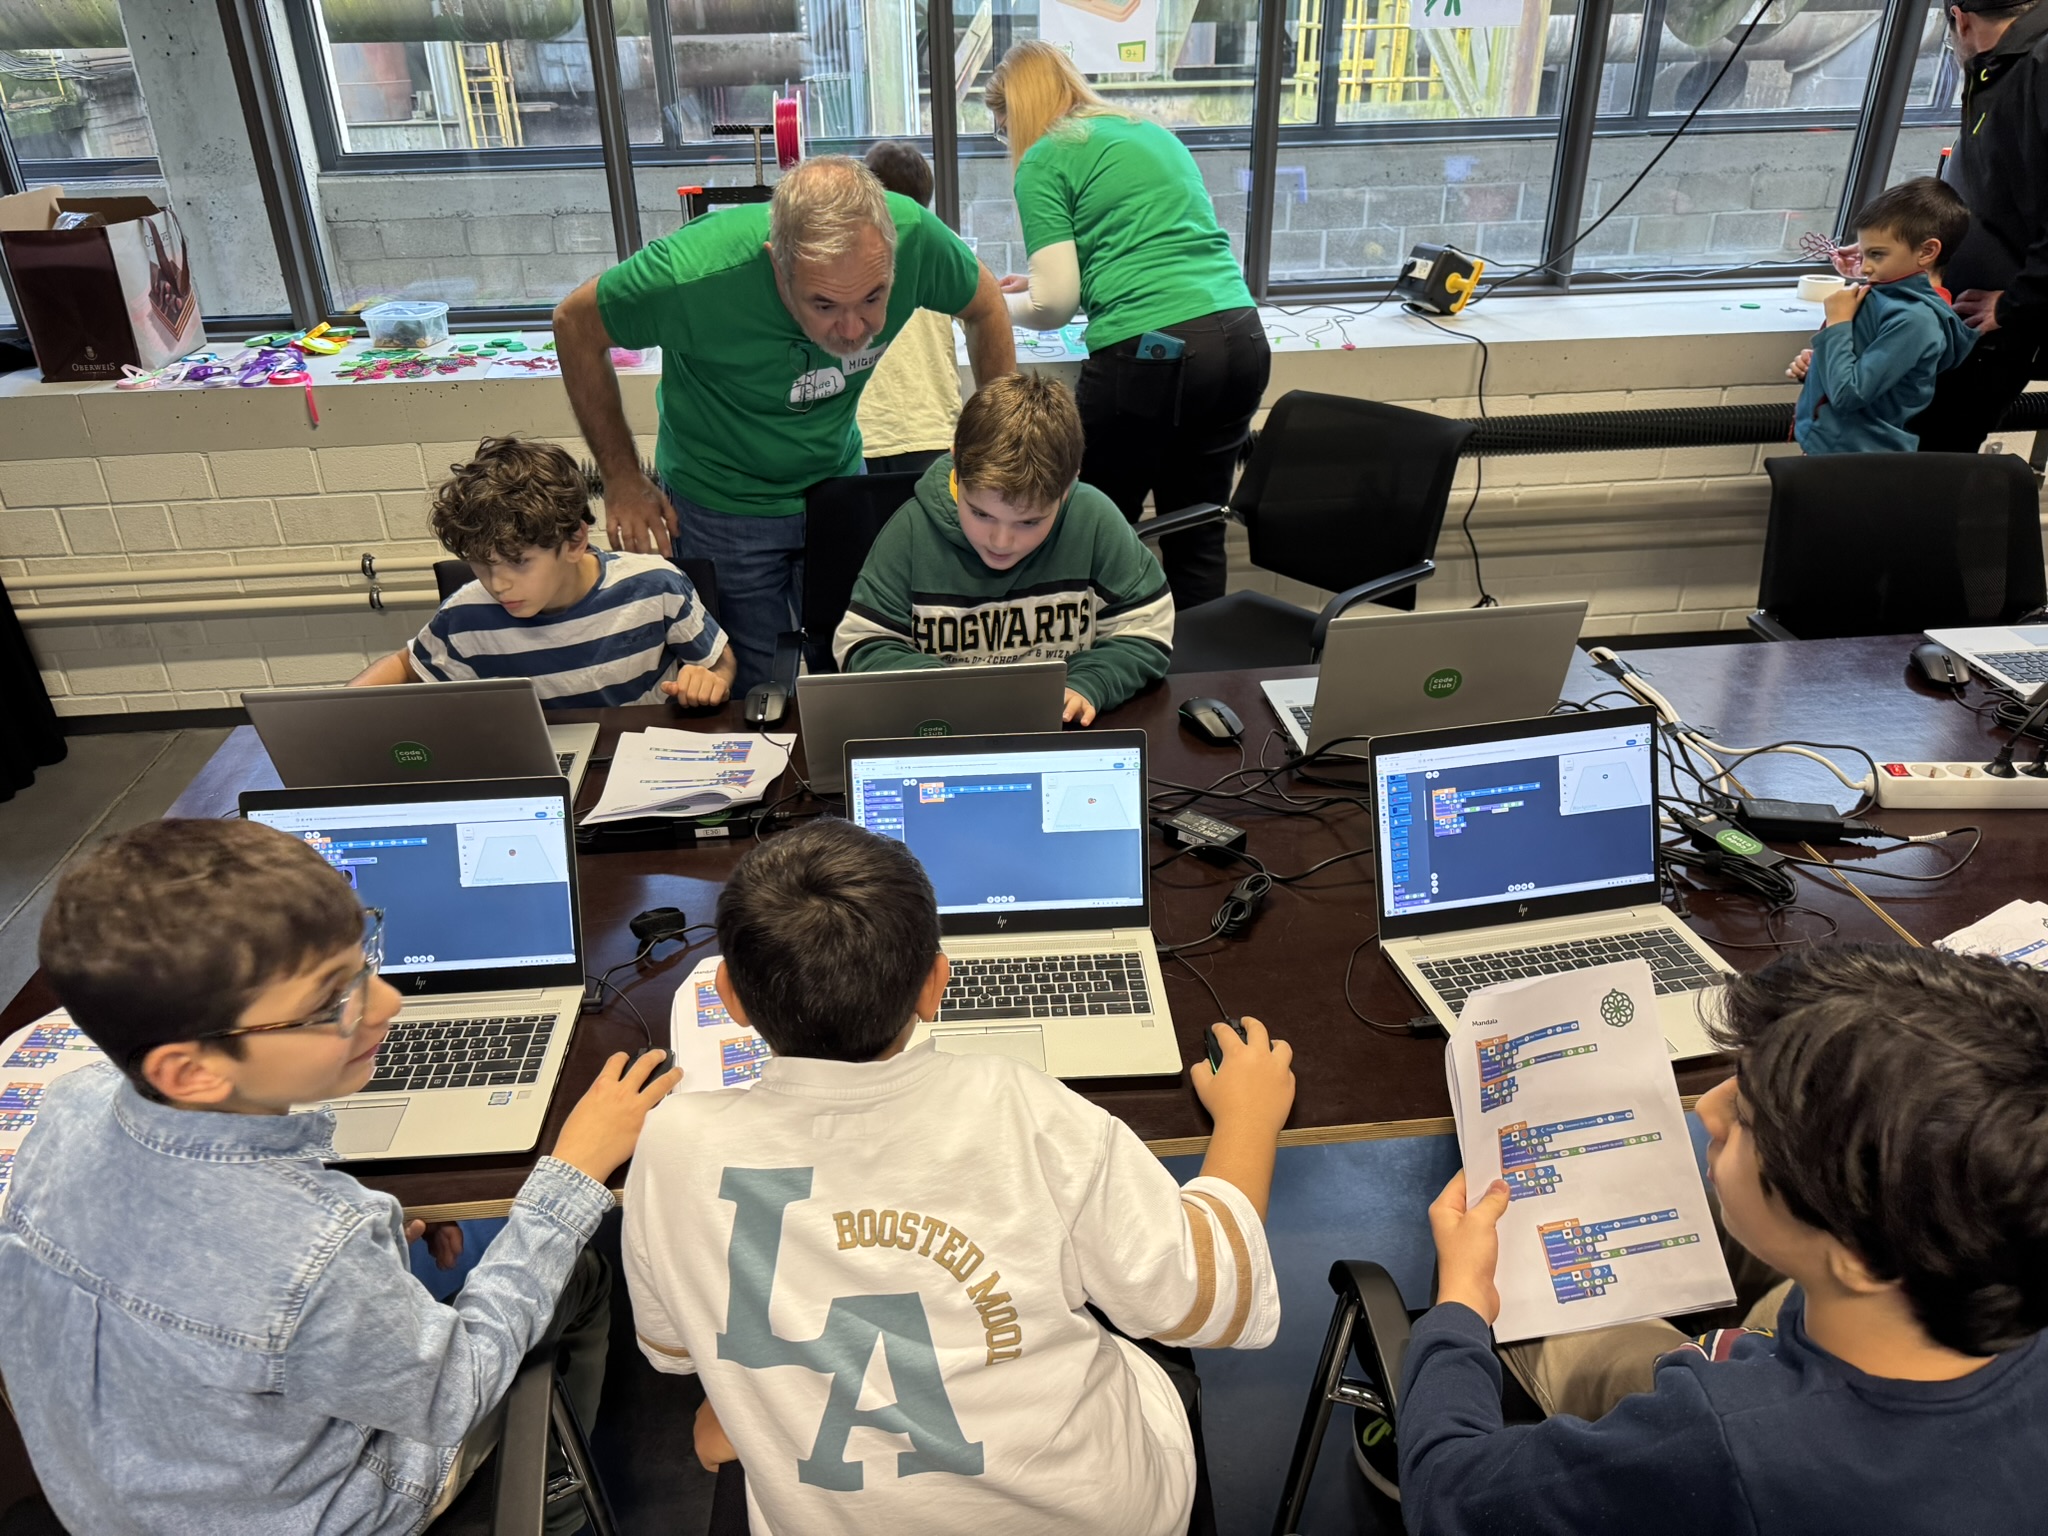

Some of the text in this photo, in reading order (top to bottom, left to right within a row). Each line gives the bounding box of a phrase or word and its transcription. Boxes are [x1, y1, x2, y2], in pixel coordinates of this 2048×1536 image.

[1125, 49, 1137, 58] 9+
[71, 362, 116, 372] OBERWEIS
[912, 598, 1090, 654] HOGWARTS
[1472, 1018, 1498, 1027] Mandala
[832, 1209, 984, 1283] BOOSTED
